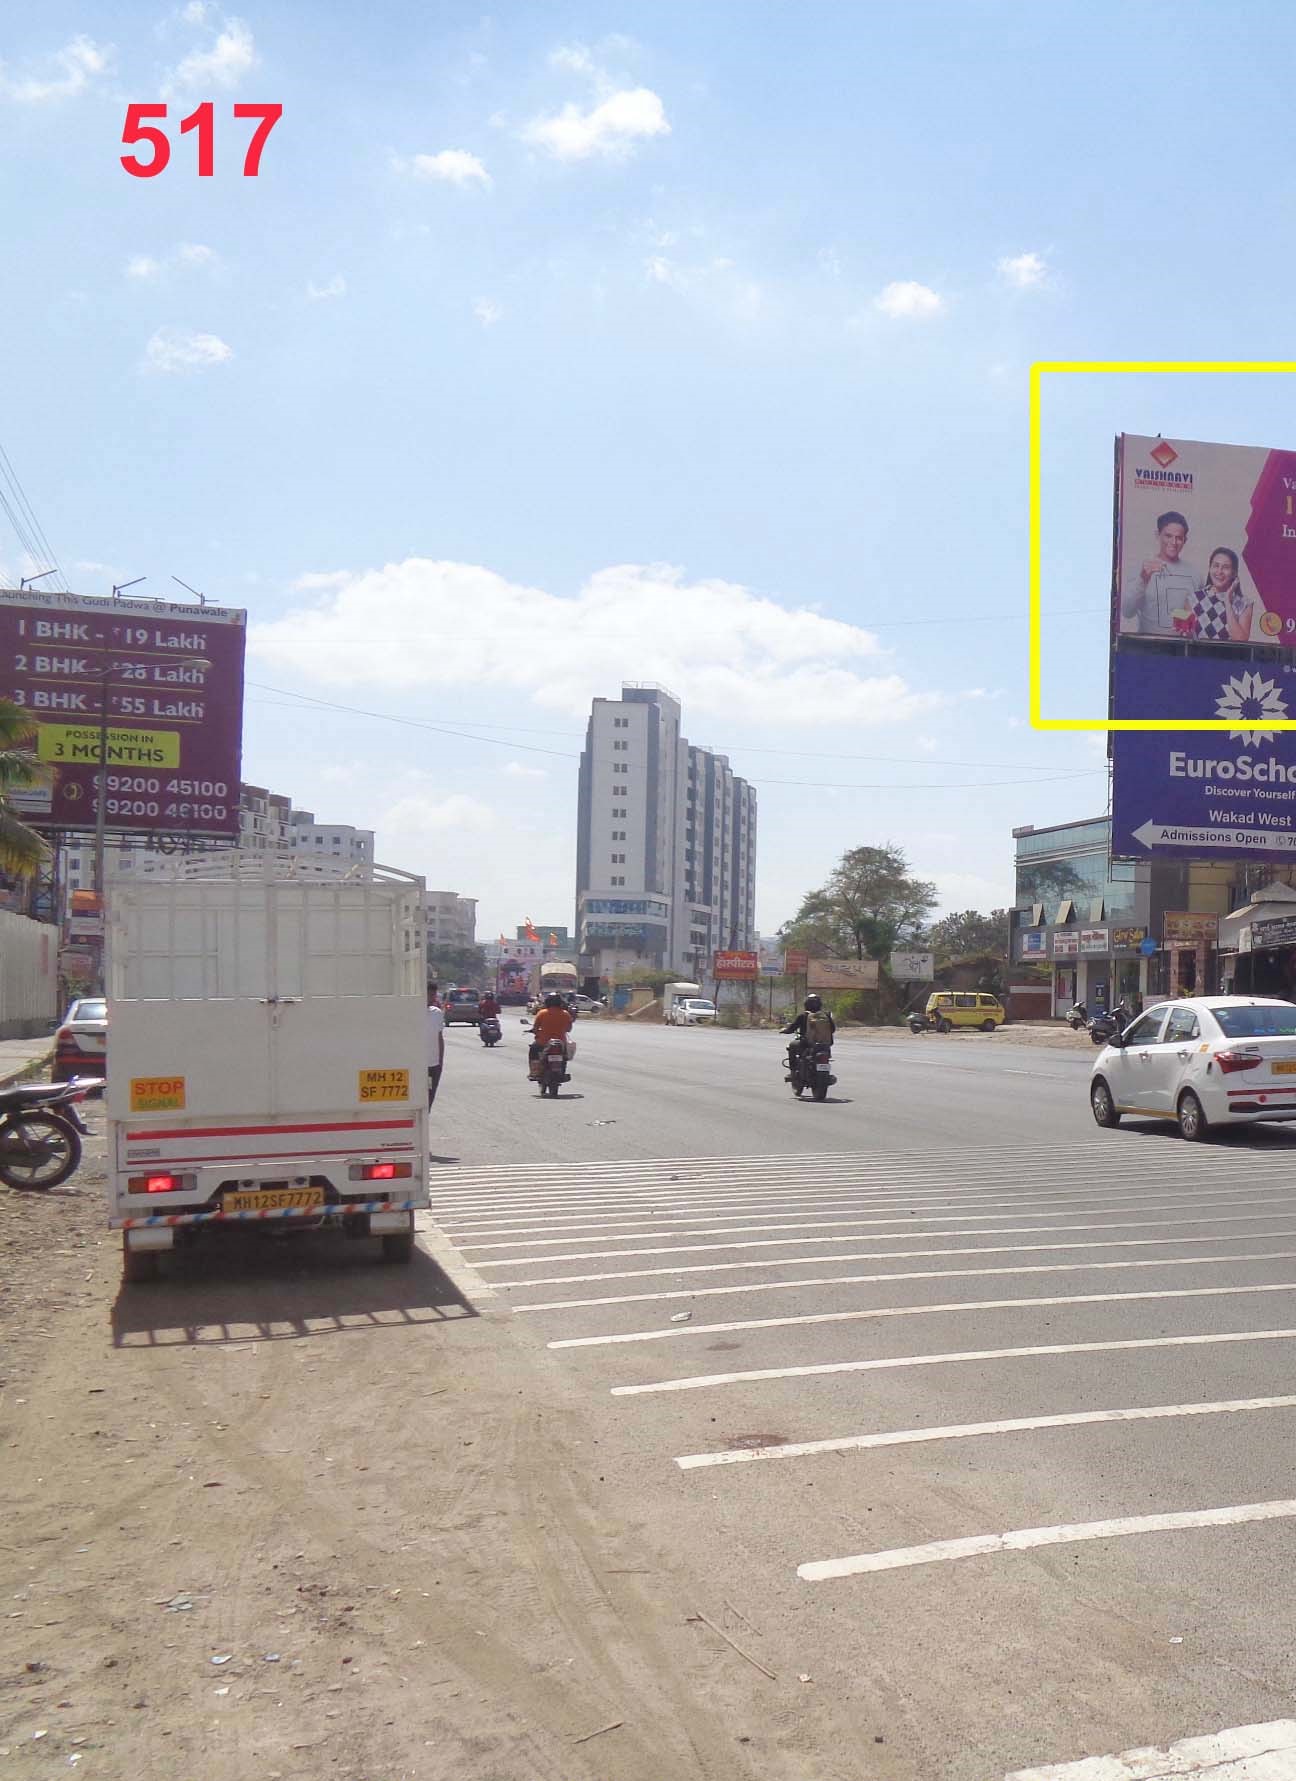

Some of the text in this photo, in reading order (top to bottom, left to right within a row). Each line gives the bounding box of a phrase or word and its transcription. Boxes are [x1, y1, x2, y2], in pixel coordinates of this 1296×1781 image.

[1286, 495, 1293, 515] 1
[1282, 524, 1296, 538] In
[0, 590, 52, 605] aunching
[170, 603, 228, 617] Punawale
[18, 619, 25, 636] 1
[36, 621, 89, 640] BHK
[15, 653, 28, 671] 2
[34, 656, 87, 674] BHK
[14, 689, 26, 706] 3
[33, 691, 88, 710] BHK
[65, 730, 154, 744] POSSESION IN
[55, 743, 164, 762] 3 MONTHS
[166, 779, 228, 797] 45100
[1204, 785, 1296, 800] Discover Yourself
[1209, 809, 1292, 827] Wakad West
[1160, 829, 1232, 843] Admissions
[1235, 832, 1267, 846] Open
[367, 1071, 403, 1082] MH 12
[135, 1080, 185, 1095] STOP
[360, 1085, 408, 1098] SF 7772
[232, 1191, 321, 1210] MH12SF7772
